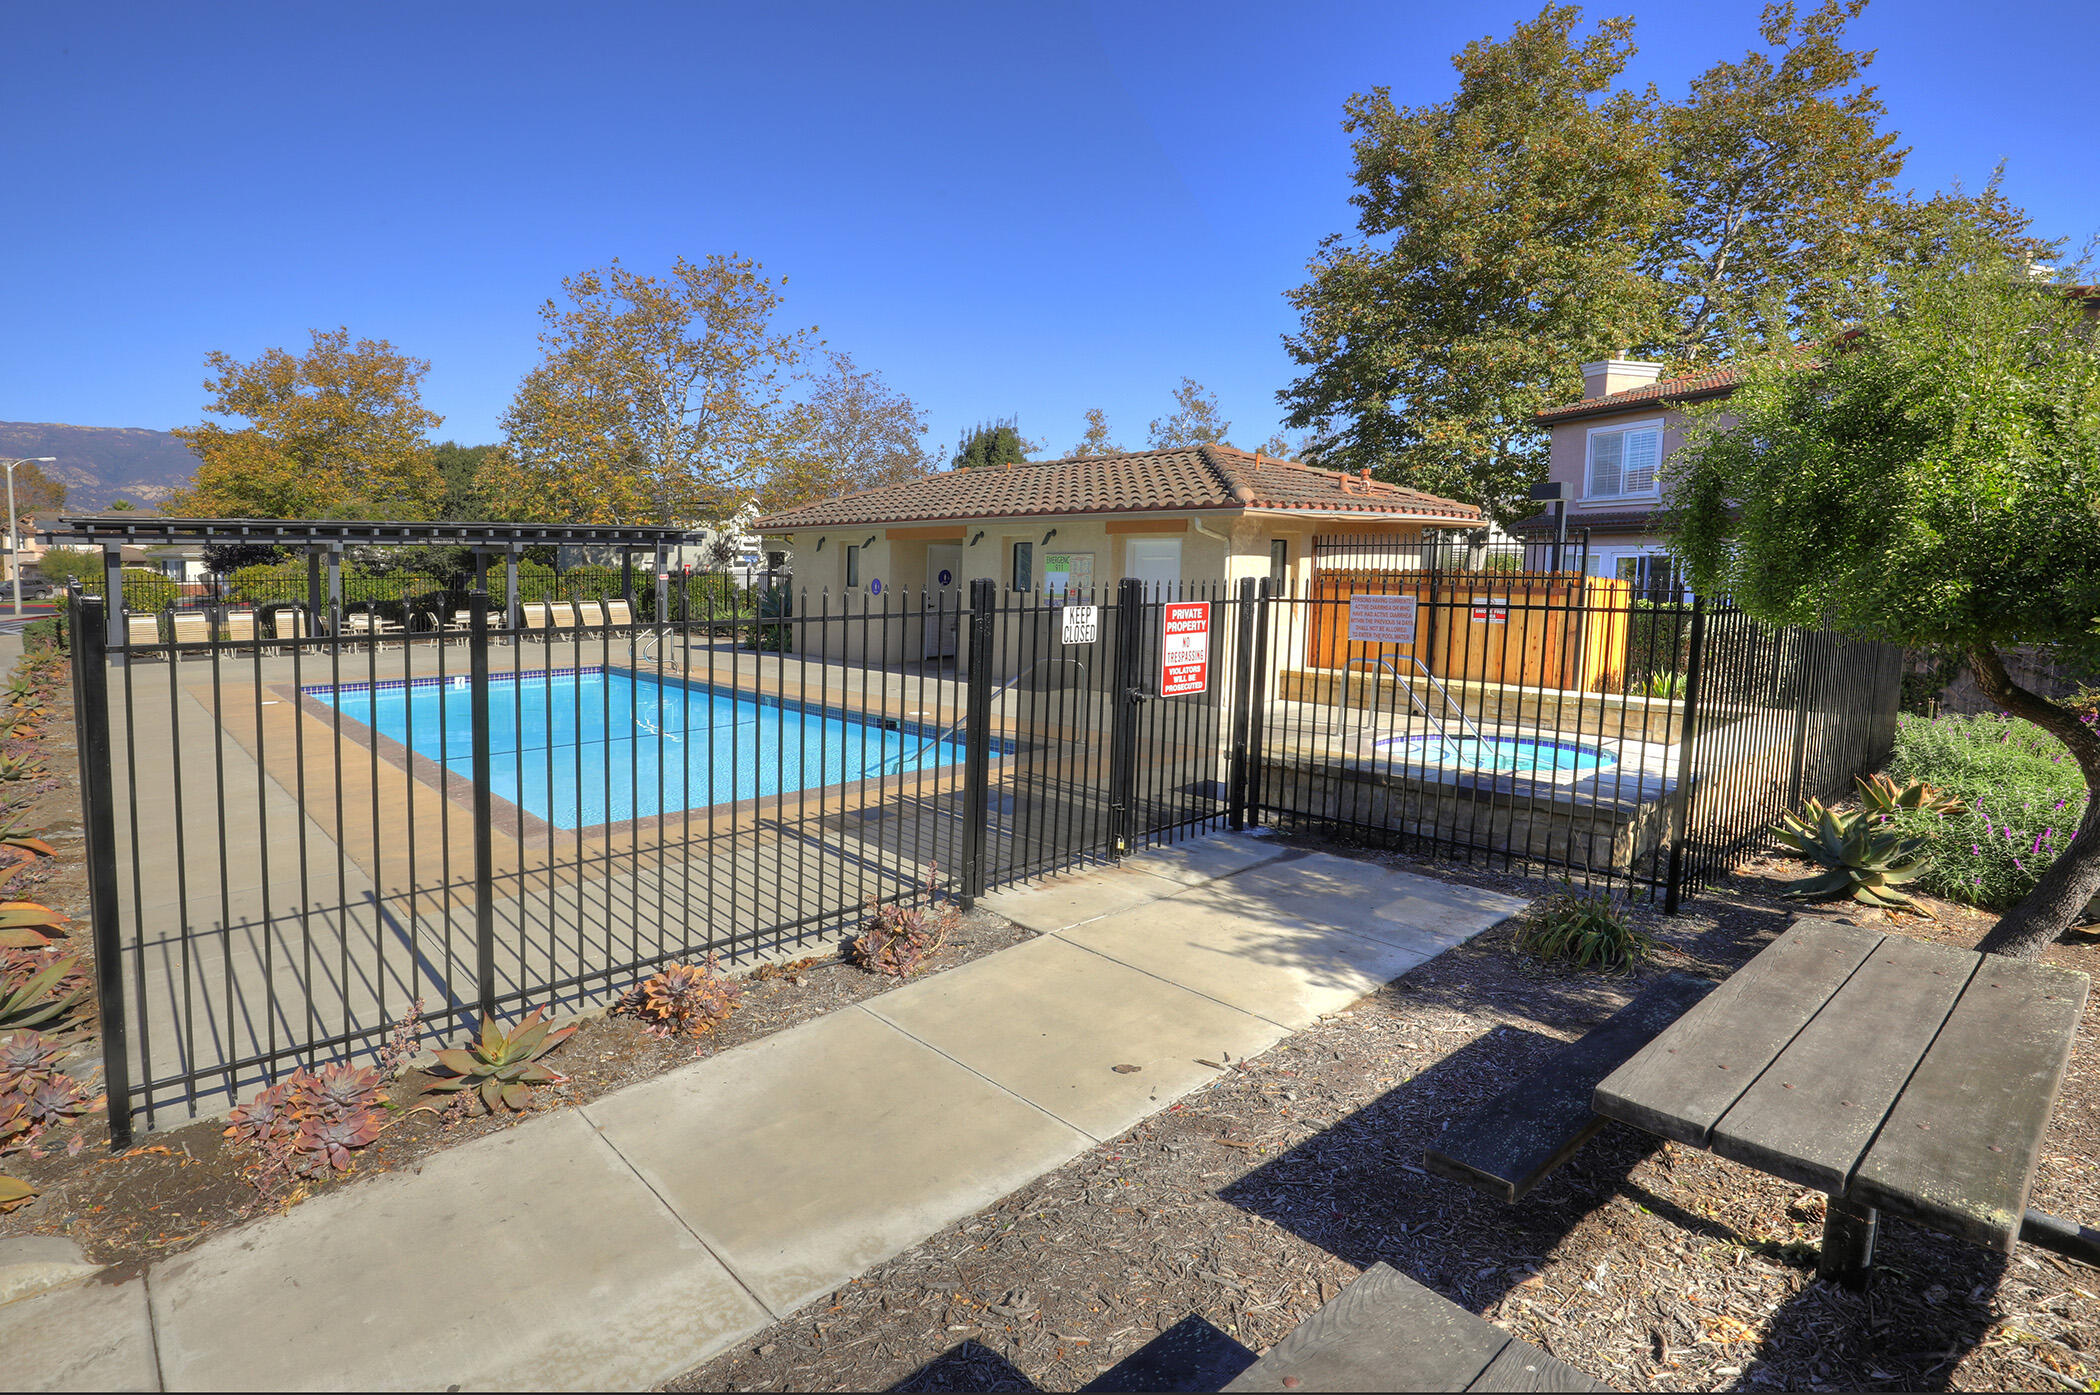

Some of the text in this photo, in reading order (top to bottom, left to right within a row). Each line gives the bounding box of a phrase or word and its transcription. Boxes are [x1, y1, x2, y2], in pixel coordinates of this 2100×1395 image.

[1046, 555, 1070, 564] EMERGENC
[1069, 606, 1092, 624] KEEP
[1172, 608, 1203, 620] PRIVATE
[1167, 620, 1206, 632] PROPERTY
[1064, 624, 1096, 643] CLOSED
[1182, 637, 1191, 648] NO
[1167, 650, 1203, 663] TRESPASSING
[1169, 665, 1201, 675] VIOLATORS
[1173, 675, 1188, 683] WILL
[1165, 681, 1203, 692] PROSECUTED
